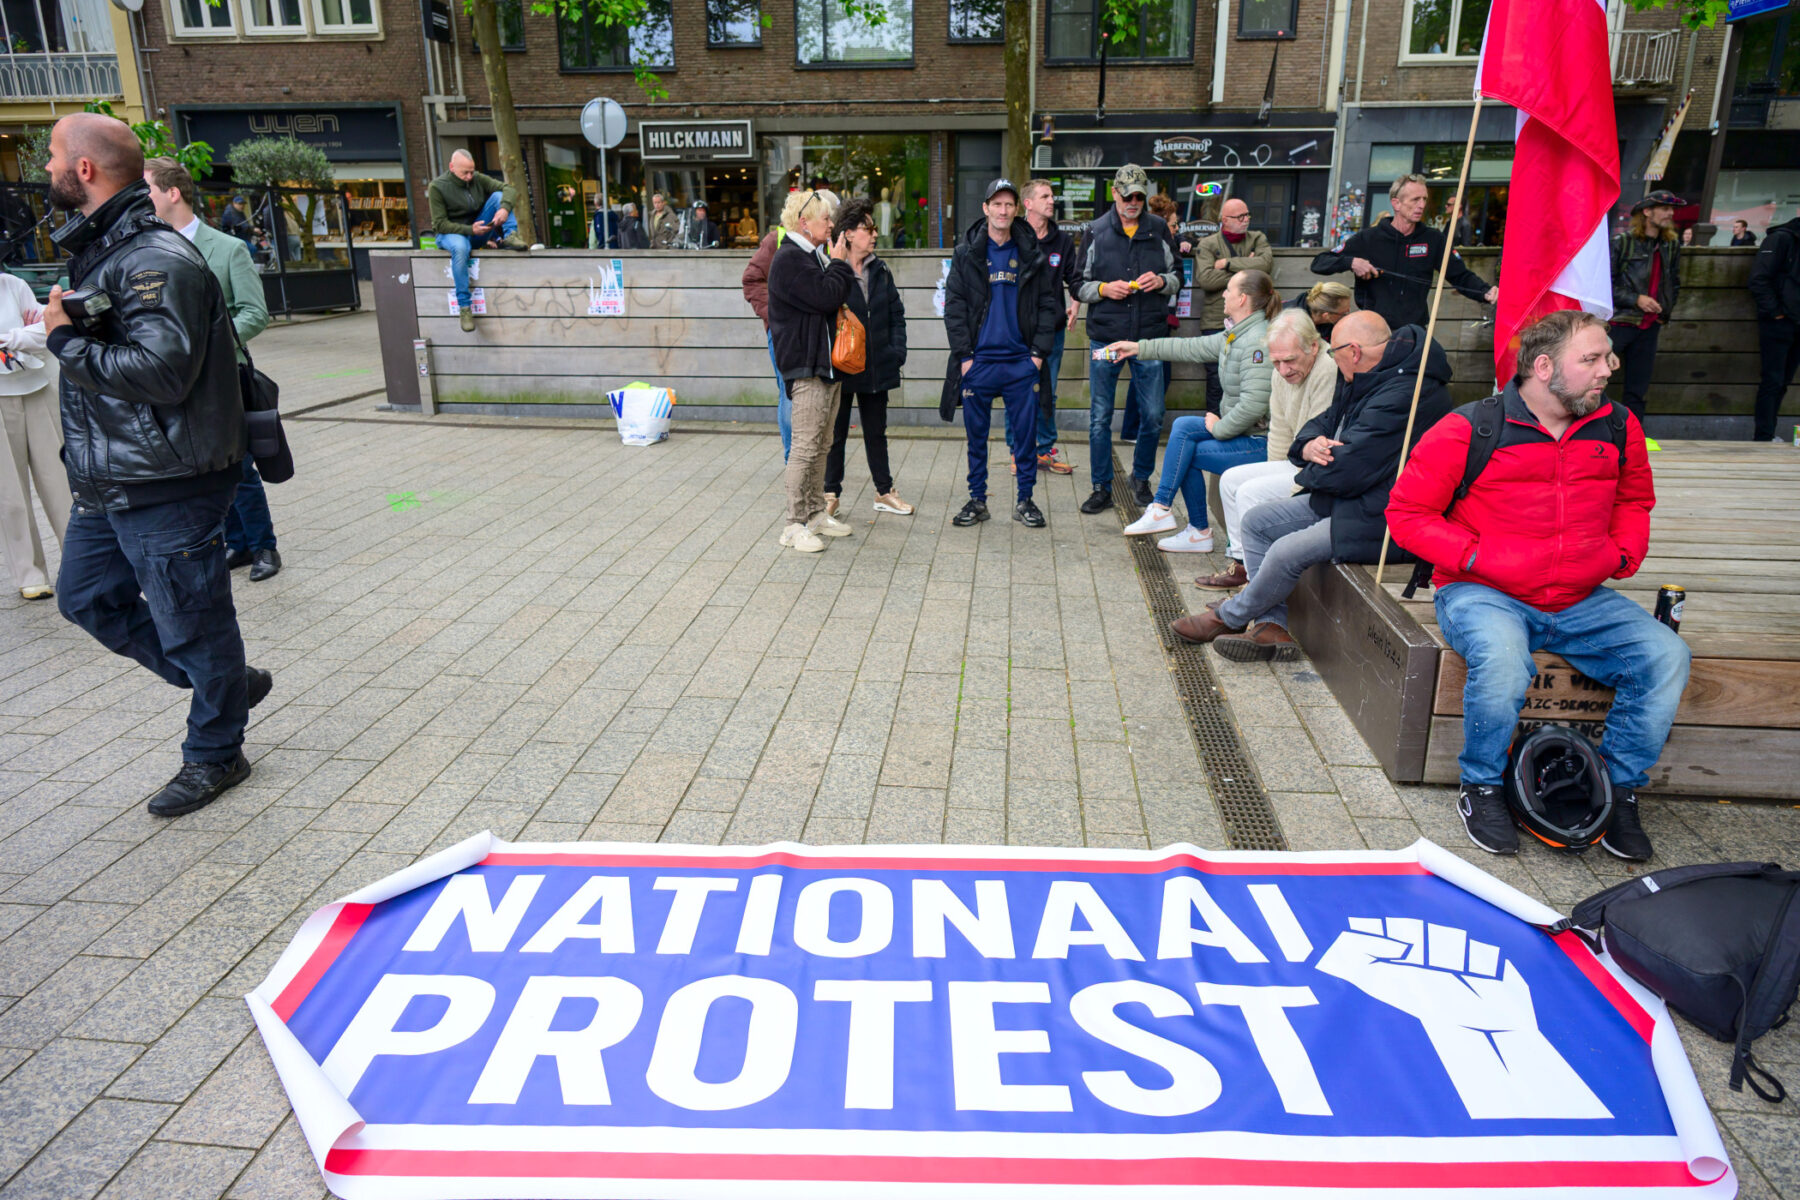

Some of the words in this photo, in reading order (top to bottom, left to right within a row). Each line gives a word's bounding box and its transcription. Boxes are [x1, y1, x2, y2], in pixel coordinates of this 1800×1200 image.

[648, 130, 743, 148] HILCKMANN
[1153, 138, 1213, 155] BARBERSHOP
[1196, 184, 1222, 195] OPEN
[1533, 674, 1555, 689] IK
[320, 973, 1334, 1117] PROTEST
